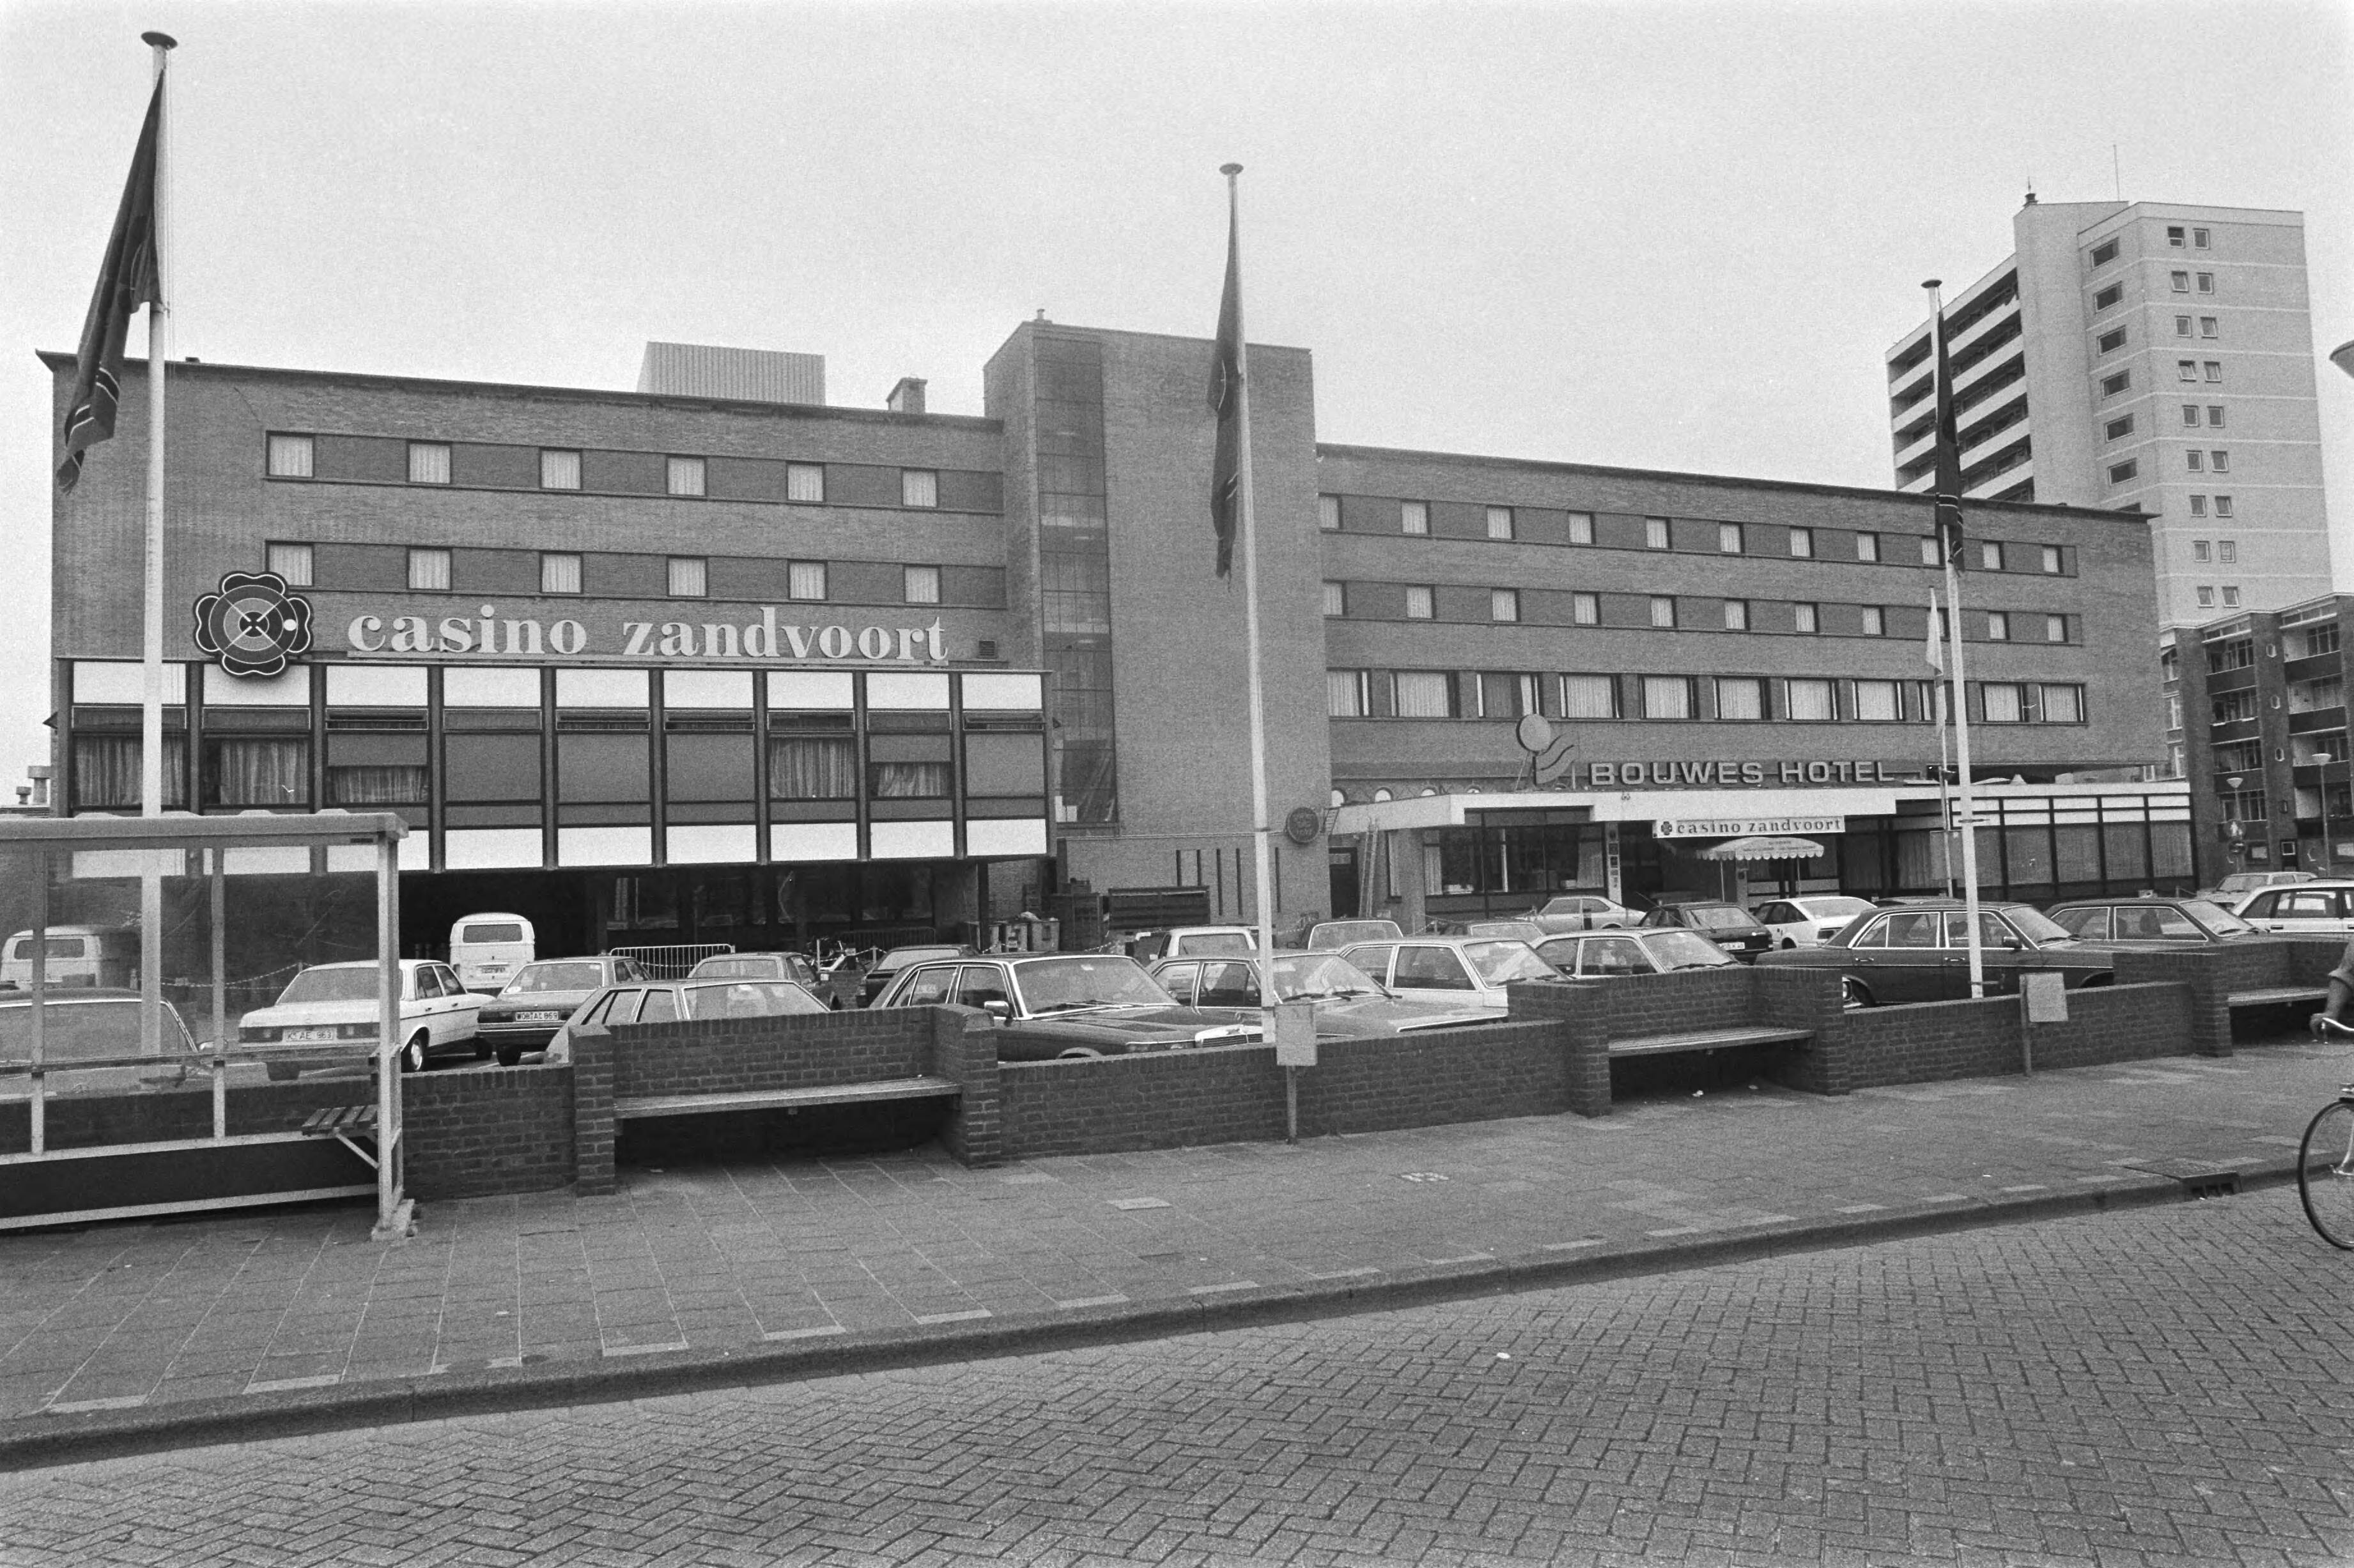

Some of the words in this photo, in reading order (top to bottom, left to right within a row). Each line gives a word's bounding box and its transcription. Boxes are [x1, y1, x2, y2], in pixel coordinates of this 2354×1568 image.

[348, 604, 587, 655] casino
[623, 607, 949, 660] zandvoort
[1590, 761, 1763, 786] BOUWES
[1780, 761, 1895, 782] HOTEL
[1677, 820, 1741, 834] casino
[1749, 818, 1841, 832] zandvoort
